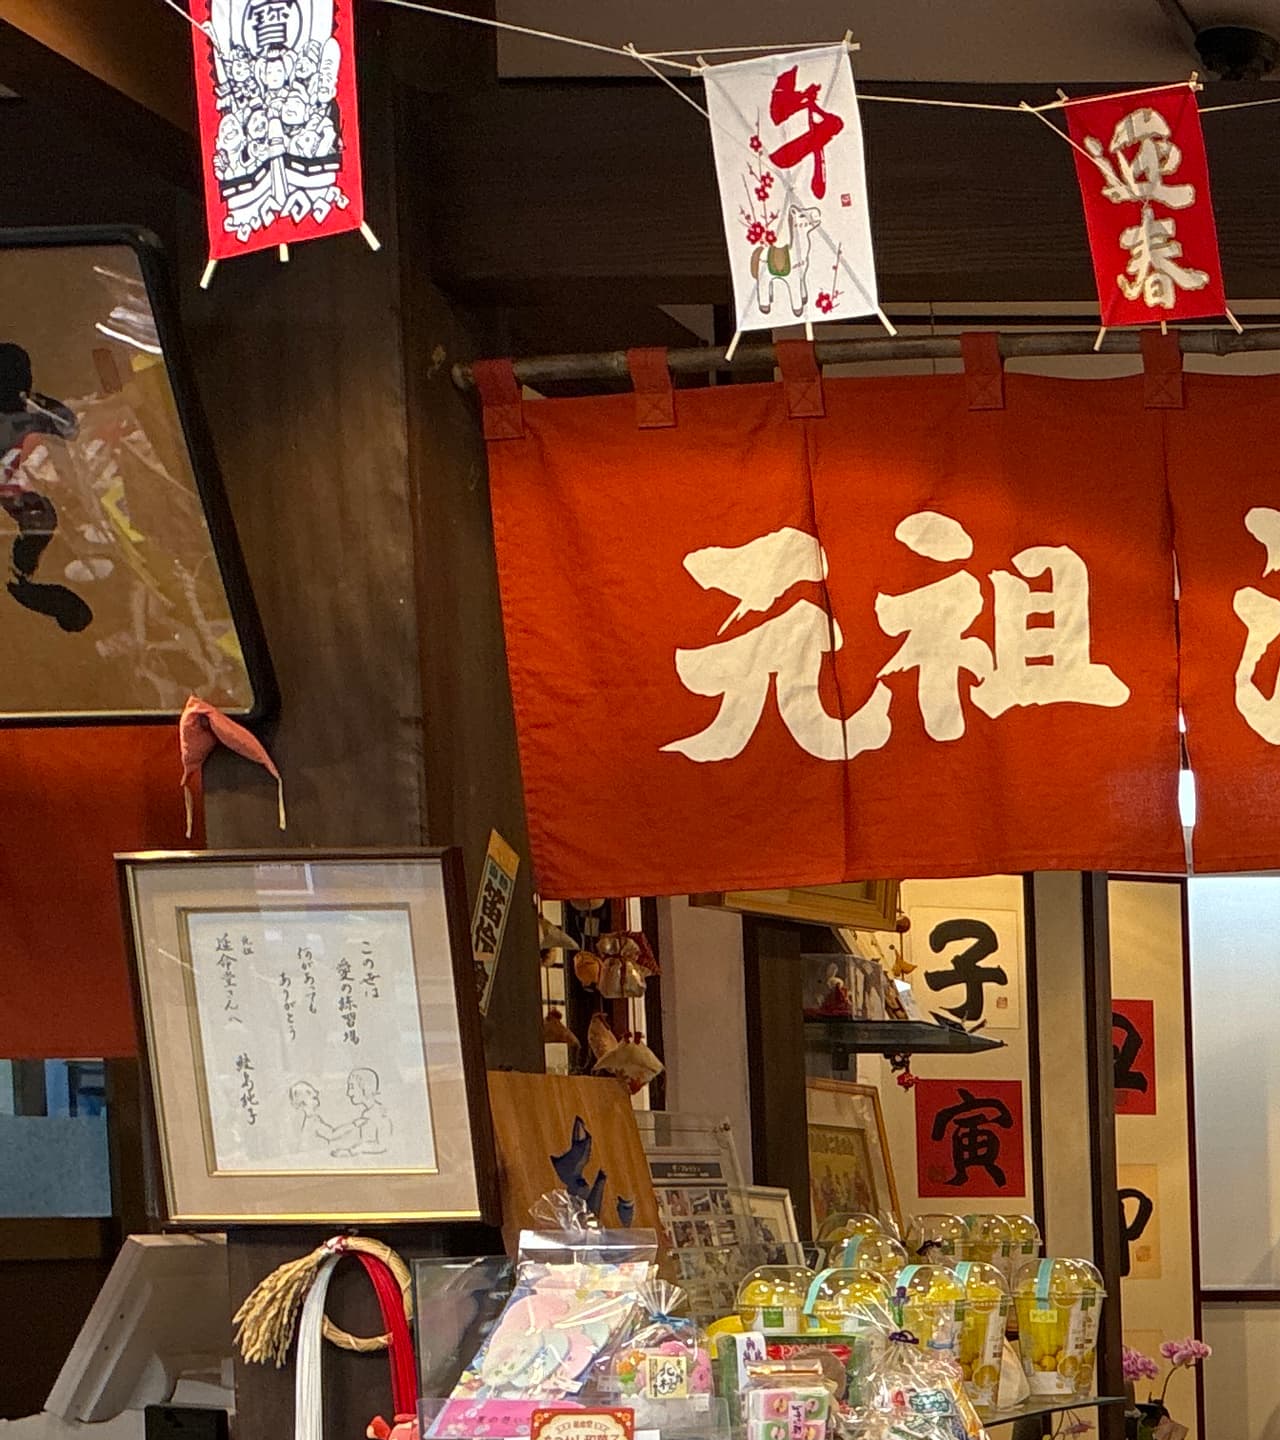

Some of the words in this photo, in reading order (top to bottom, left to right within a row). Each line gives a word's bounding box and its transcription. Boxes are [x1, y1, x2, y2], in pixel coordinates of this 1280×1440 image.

[768, 65, 845, 199] 午
[1085, 107, 1209, 310] 迎春
[660, 510, 1130, 762] 元祖
[924, 917, 1009, 1022] 子
[931, 1087, 1015, 1189] 寅
